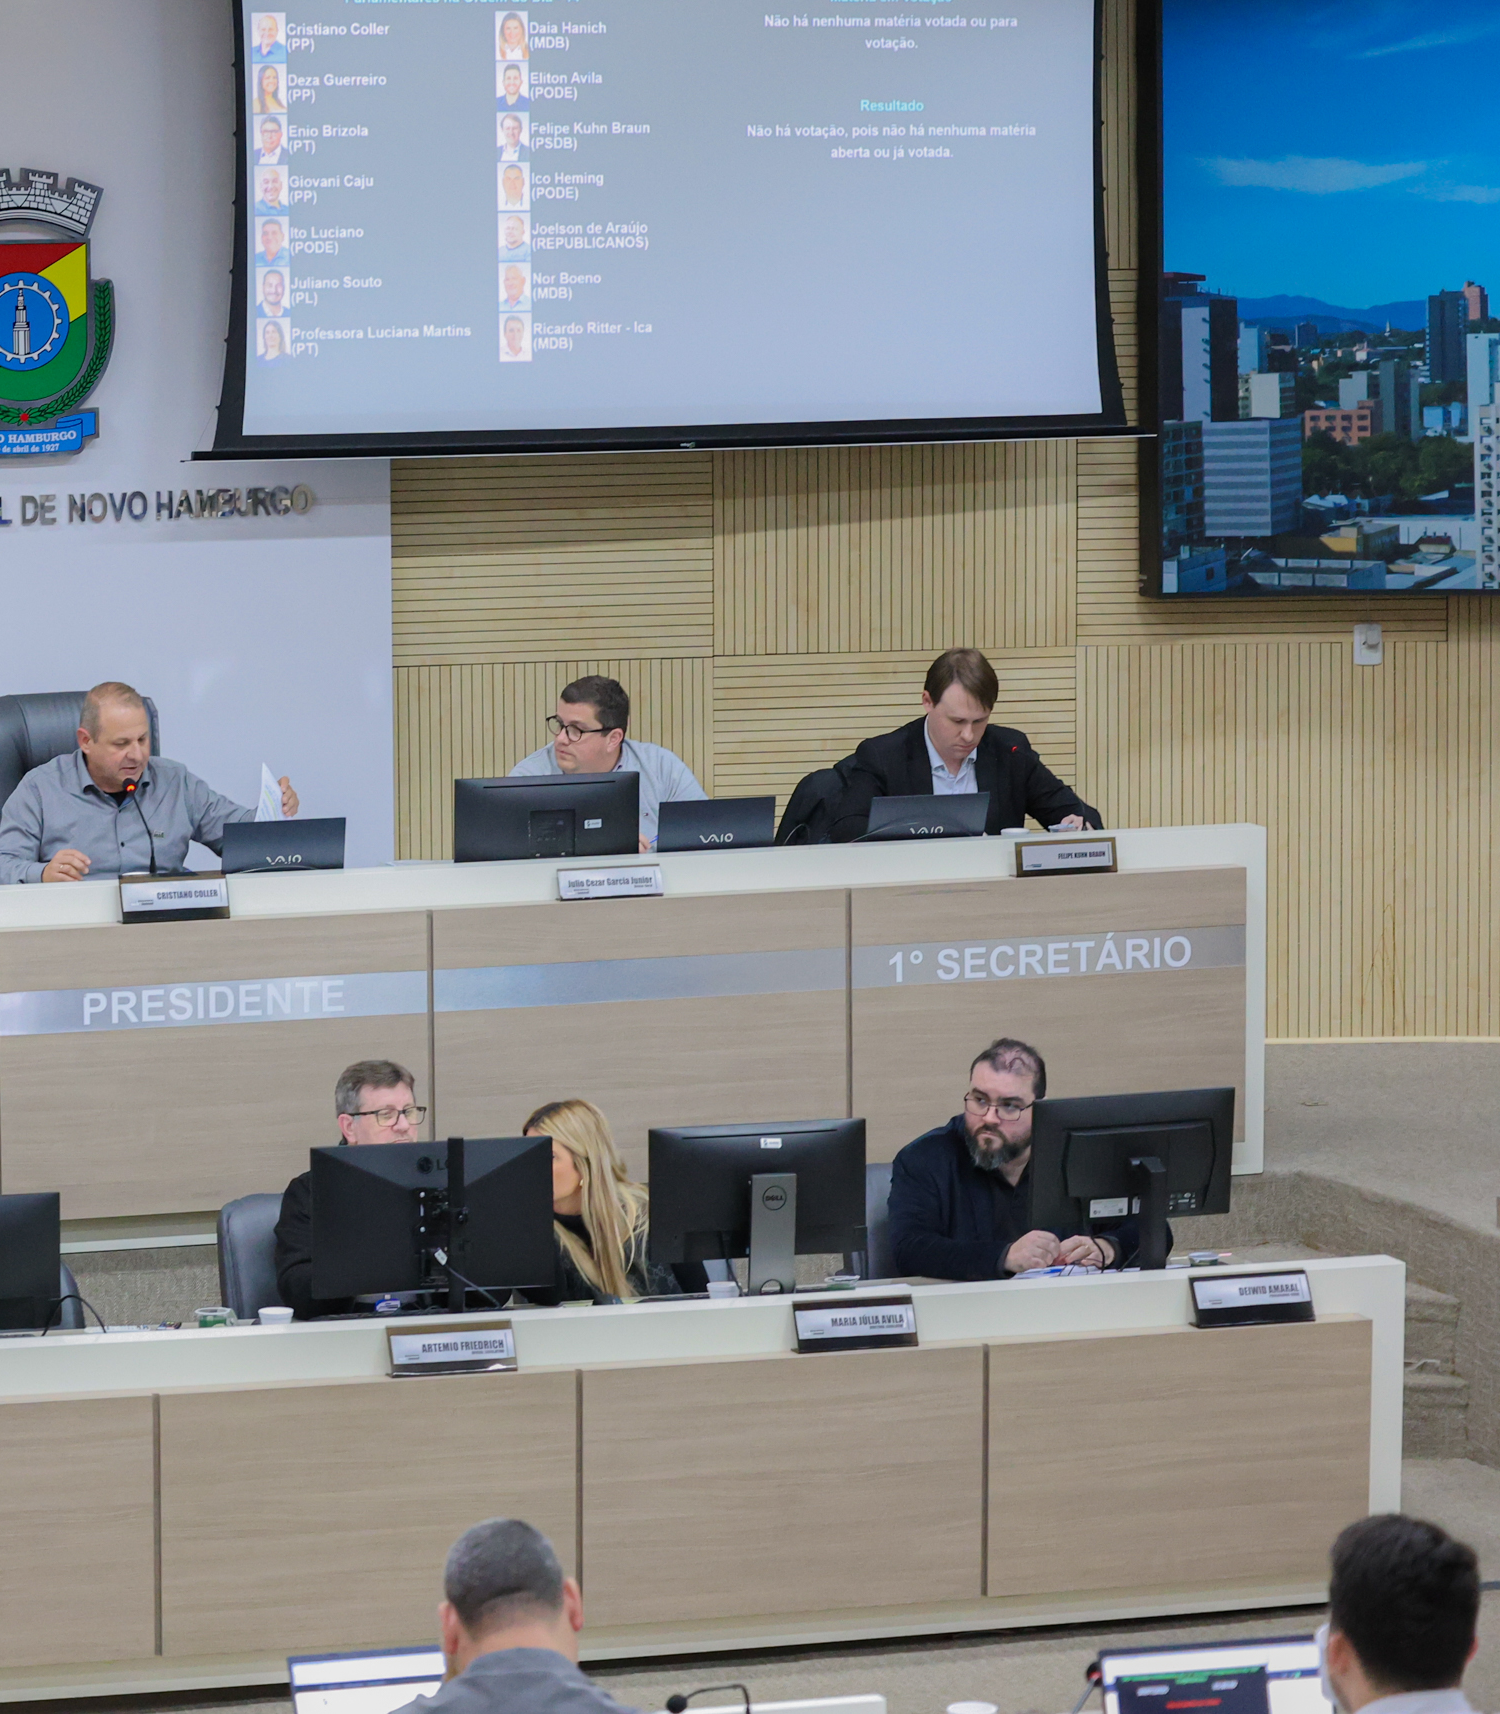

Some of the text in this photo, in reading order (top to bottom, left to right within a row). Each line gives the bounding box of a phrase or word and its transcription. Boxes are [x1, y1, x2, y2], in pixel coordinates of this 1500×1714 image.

[286, 22, 390, 36] Cristiano Coller
[529, 21, 607, 34] Daia Hanich
[764, 13, 1018, 30] Não há nenhuma matéria votada ou para
[287, 38, 315, 53] (PP)
[529, 37, 570, 51] (MDB)
[865, 36, 918, 51] votação.
[288, 73, 387, 86] Deza Guerreiro
[530, 72, 568, 84] Eliton
[288, 89, 315, 104] (PP)
[530, 86, 578, 102] (PODE)
[860, 99, 924, 111] Resultado
[288, 124, 369, 137] Enio Brizola
[530, 121, 650, 136] Felipe Kuhn Braun
[747, 122, 1036, 139] Não há votação, pois não há nenhuma matéria
[289, 140, 316, 155] (PT)
[531, 137, 578, 152] (PSDB)
[831, 145, 954, 160] aberta ou já votada.
[289, 174, 374, 190] Giovani Caju
[531, 171, 604, 187] Ico Heming
[289, 190, 317, 206] (PP)
[531, 186, 579, 202] (PODE)
[290, 225, 364, 239] Ito Luciano
[532, 220, 648, 236] Joelson de Araújo
[290, 241, 339, 256] (PODE)
[532, 236, 649, 252] (REPUBLICANOS)
[291, 276, 383, 289] Juliano Souto
[532, 272, 602, 284] Nor Boeno
[291, 292, 318, 307] (PL)
[532, 286, 573, 302] (MDB)
[292, 324, 472, 340] Professora Luciana Martins
[533, 322, 584, 335] Ricardo
[587, 321, 622, 334] Ritter
[634, 321, 652, 333] Ica
[292, 342, 319, 358] (PT)
[533, 336, 573, 352] (MDB)
[8, 430, 77, 443] HAMBURGO
[2, 445, 11, 453] de
[12, 445, 29, 453] abril
[30, 444, 40, 452] de
[41, 443, 60, 452] 1927
[20, 494, 58, 526] DE
[68, 490, 148, 524] NOVO
[155, 483, 315, 522] HAMBURGO
[699, 833, 734, 844] VAIO
[266, 854, 302, 865] VAIO
[1058, 852, 1074, 860] FELIPE
[568, 878, 585, 888] Julio
[585, 877, 605, 887] Cezar
[630, 875, 653, 885] Junior
[156, 888, 218, 900] CRISTIANO COLLER
[936, 931, 1192, 981] SECRETÁRIO
[83, 978, 345, 1026] PRESIDENTE
[1238, 1285, 1267, 1296] DEIWID
[1268, 1283, 1300, 1294] AMARAL
[831, 1316, 858, 1327] MARIA
[859, 1313, 880, 1326] JÚLIA
[881, 1313, 905, 1324] AVILA
[422, 1342, 459, 1353] ARTEMIO
[460, 1339, 504, 1351] FRIEDRICH
